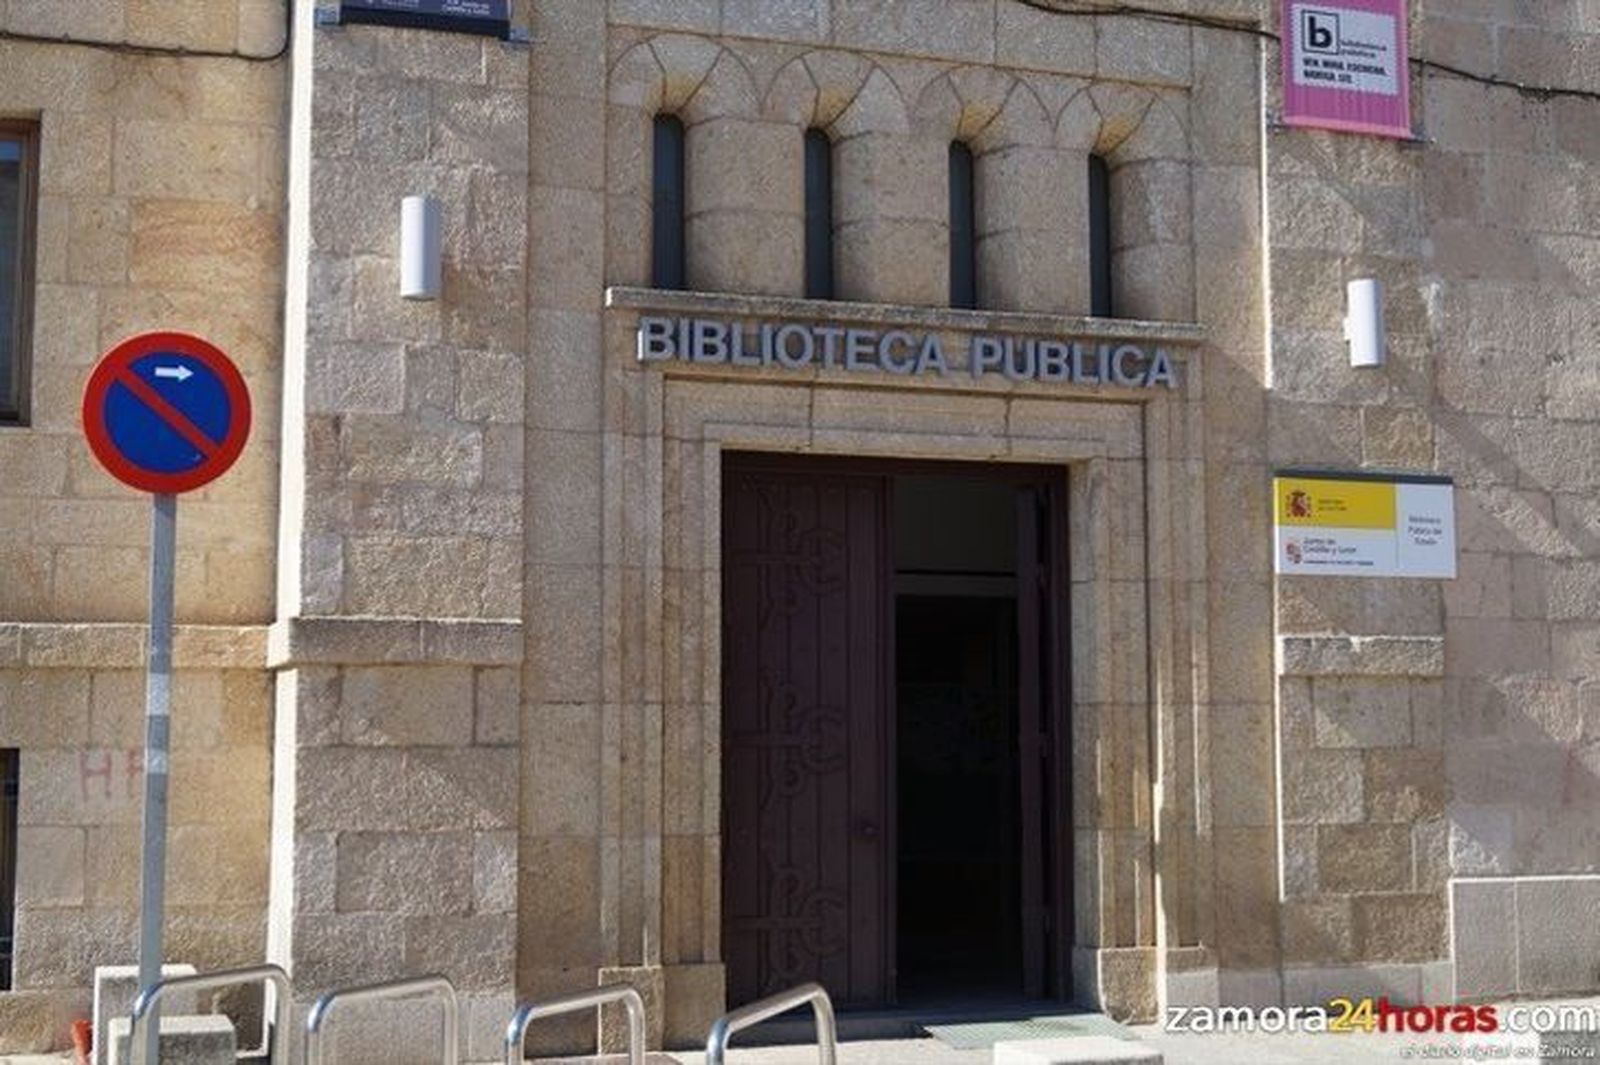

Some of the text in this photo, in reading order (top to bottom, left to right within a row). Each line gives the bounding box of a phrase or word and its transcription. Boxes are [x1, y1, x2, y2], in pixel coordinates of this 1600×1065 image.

[1308, 15, 1332, 48] b
[637, 314, 1177, 389] BIBLIOTECA PUBLICA
